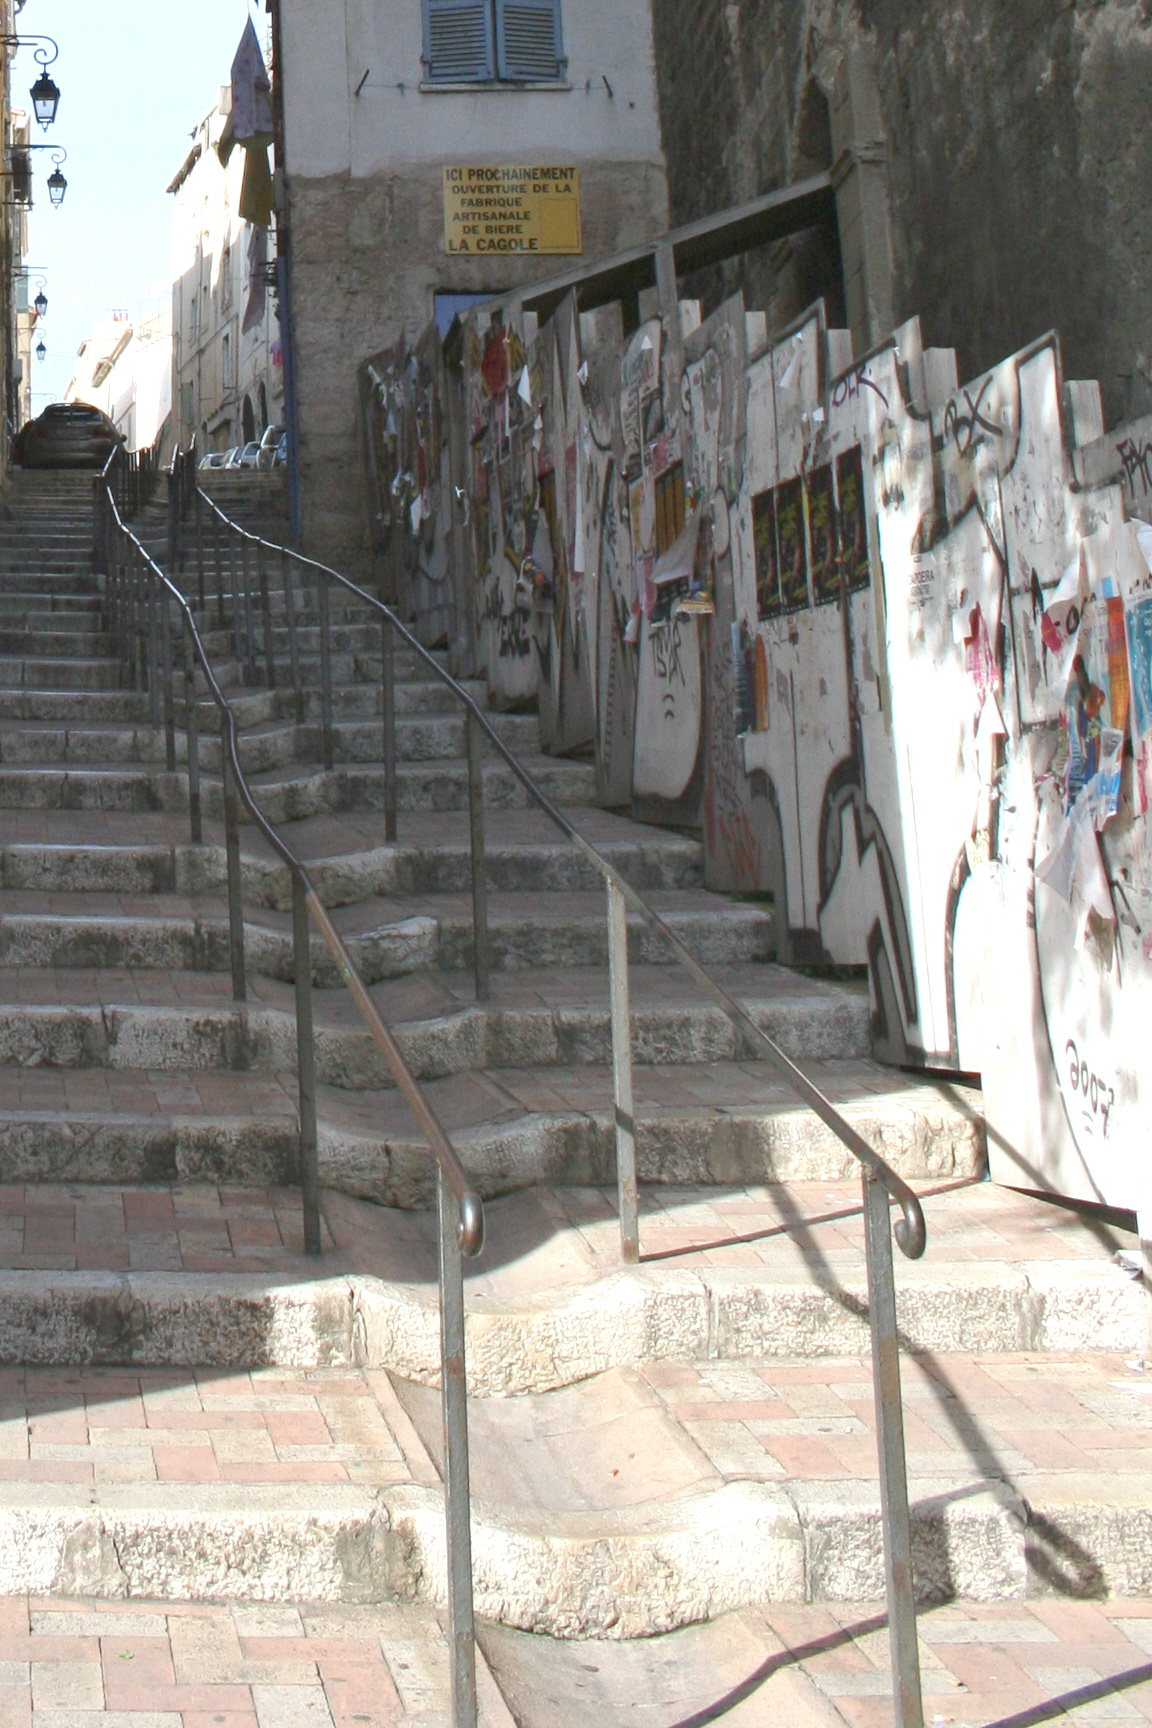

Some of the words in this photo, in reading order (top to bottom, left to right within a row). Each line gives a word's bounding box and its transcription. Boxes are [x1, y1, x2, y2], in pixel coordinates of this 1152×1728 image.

[446, 169, 463, 181] ICI
[468, 167, 575, 181] PROCHAINEMENT
[452, 184, 528, 194] OUVERTURE
[533, 184, 549, 193] DE
[555, 184, 572, 193] LA
[461, 198, 522, 207] FABRIQUE
[452, 211, 531, 221] ARTISANALE
[462, 225, 480, 234] DE
[485, 225, 524, 234] BIERE
[449, 239, 470, 251] LA
[476, 238, 538, 251] CAGOLE
